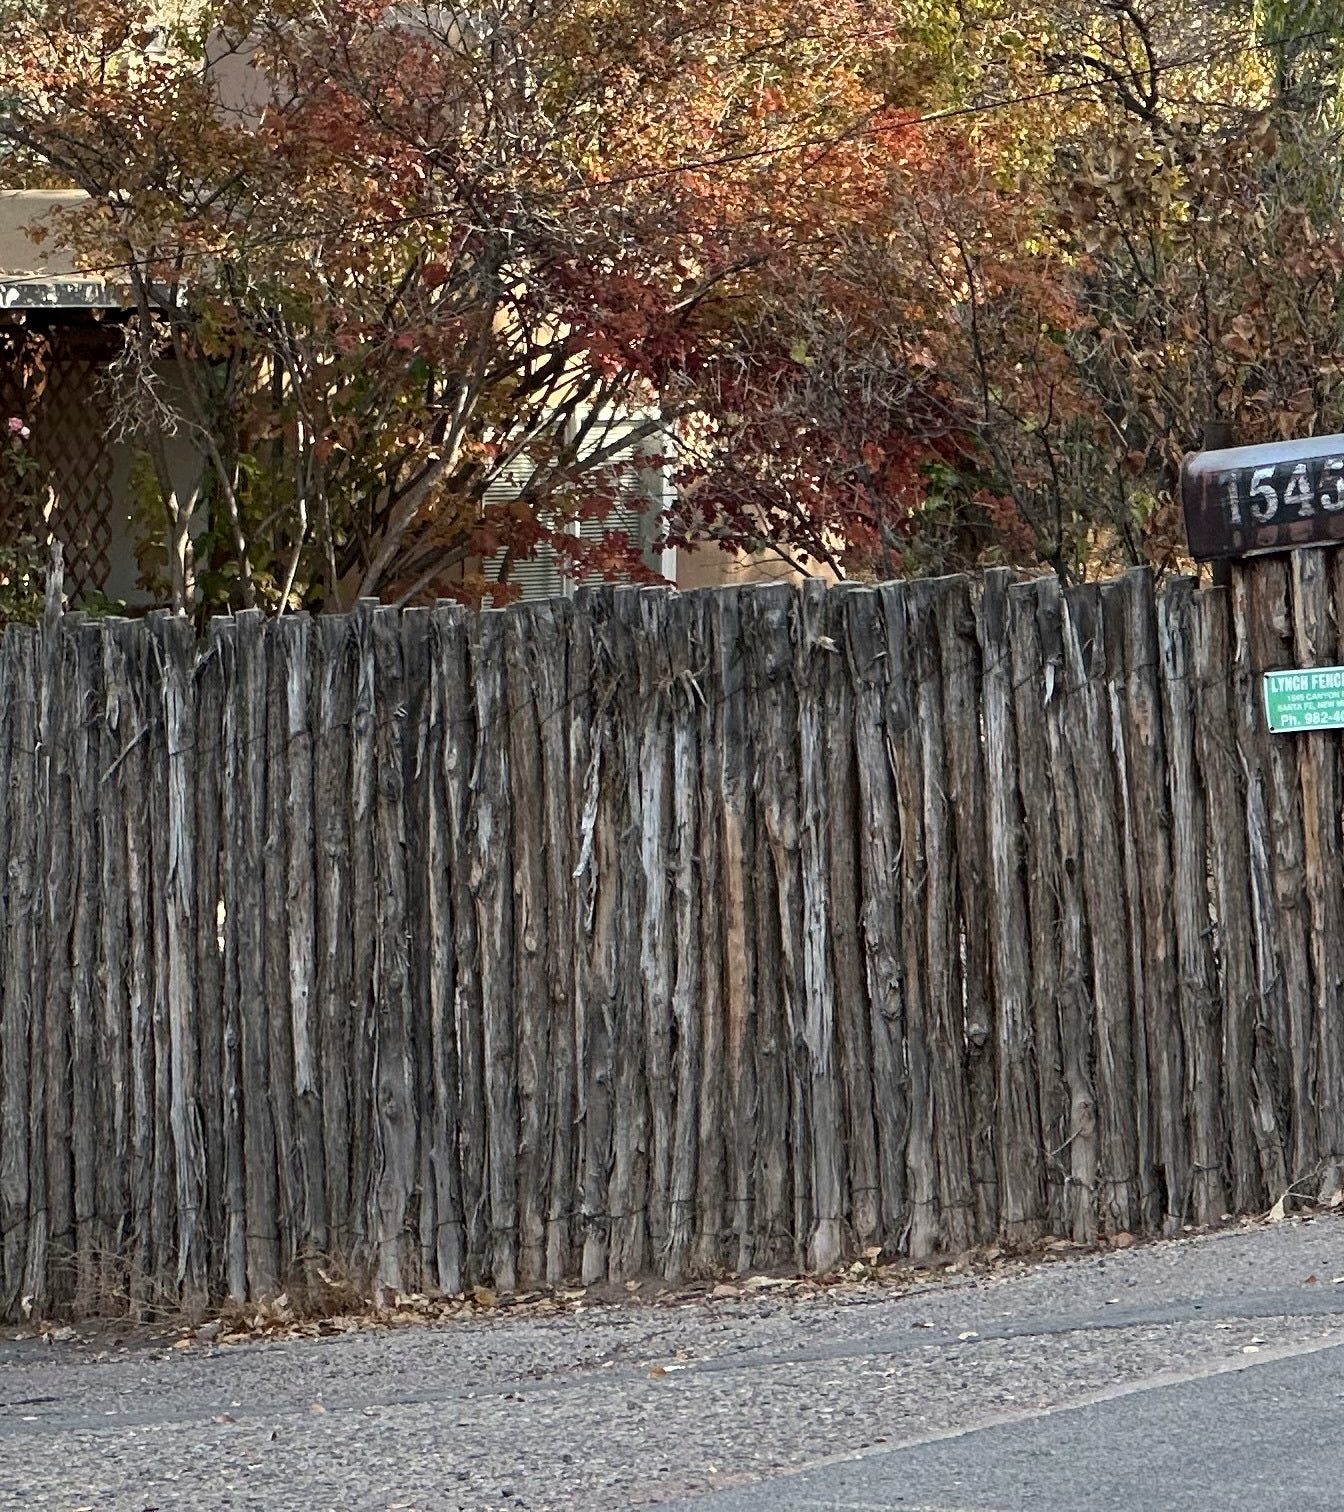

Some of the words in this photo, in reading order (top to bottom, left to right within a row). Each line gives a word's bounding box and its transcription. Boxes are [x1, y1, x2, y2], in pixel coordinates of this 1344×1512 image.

[1271, 675, 1309, 693] LYNCH
[1305, 691, 1341, 701] CANYON
[1277, 703, 1303, 712] SANTA
[1317, 700, 1335, 709] NEW
[1280, 713, 1301, 727] Ph.
